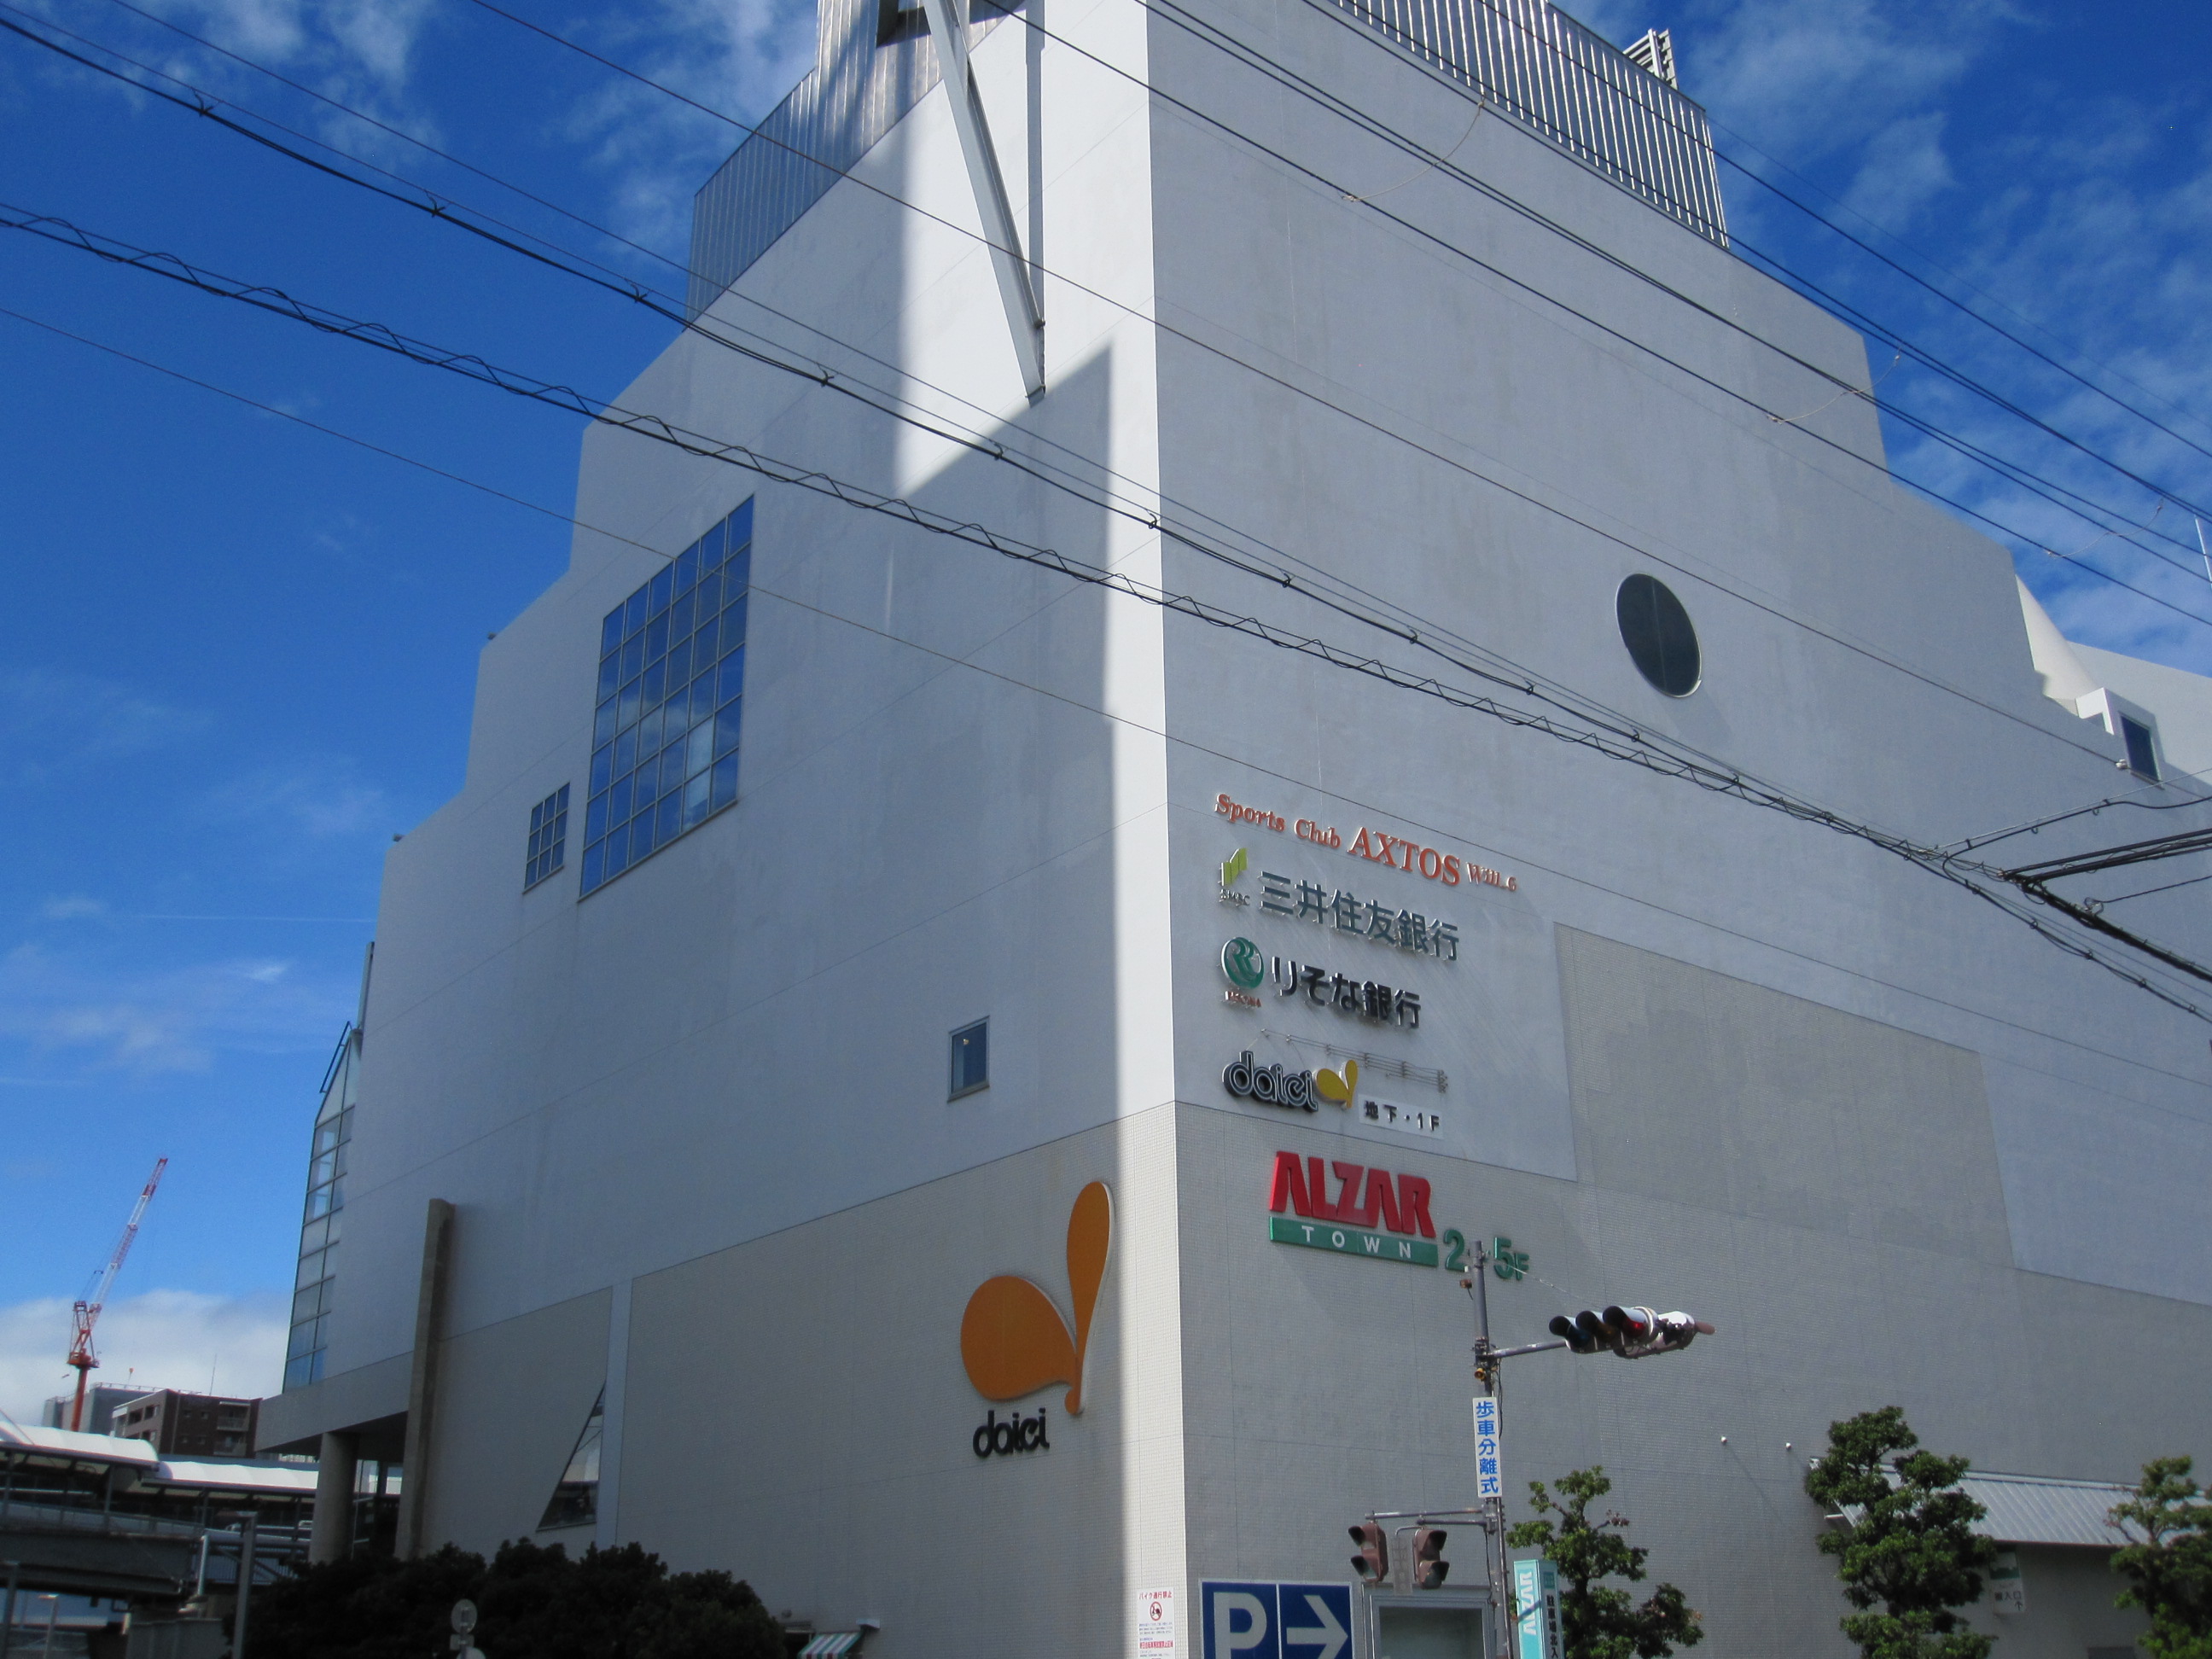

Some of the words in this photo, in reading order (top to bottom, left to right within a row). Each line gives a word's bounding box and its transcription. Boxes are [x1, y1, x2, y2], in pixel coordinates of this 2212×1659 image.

[1214, 794, 1286, 832] Sports
[1294, 818, 1342, 849] Club
[1348, 827, 1460, 886] AXTOS
[1260, 870, 1459, 961] 三井住友銀行
[1271, 956, 1421, 1027] りそな銀行
[1269, 1150, 1436, 1237] ALZAR
[1301, 1225, 1412, 1260] TOWN
[1476, 1400, 1499, 1494] 歩車分離式
[1213, 1592, 1267, 1659] P
